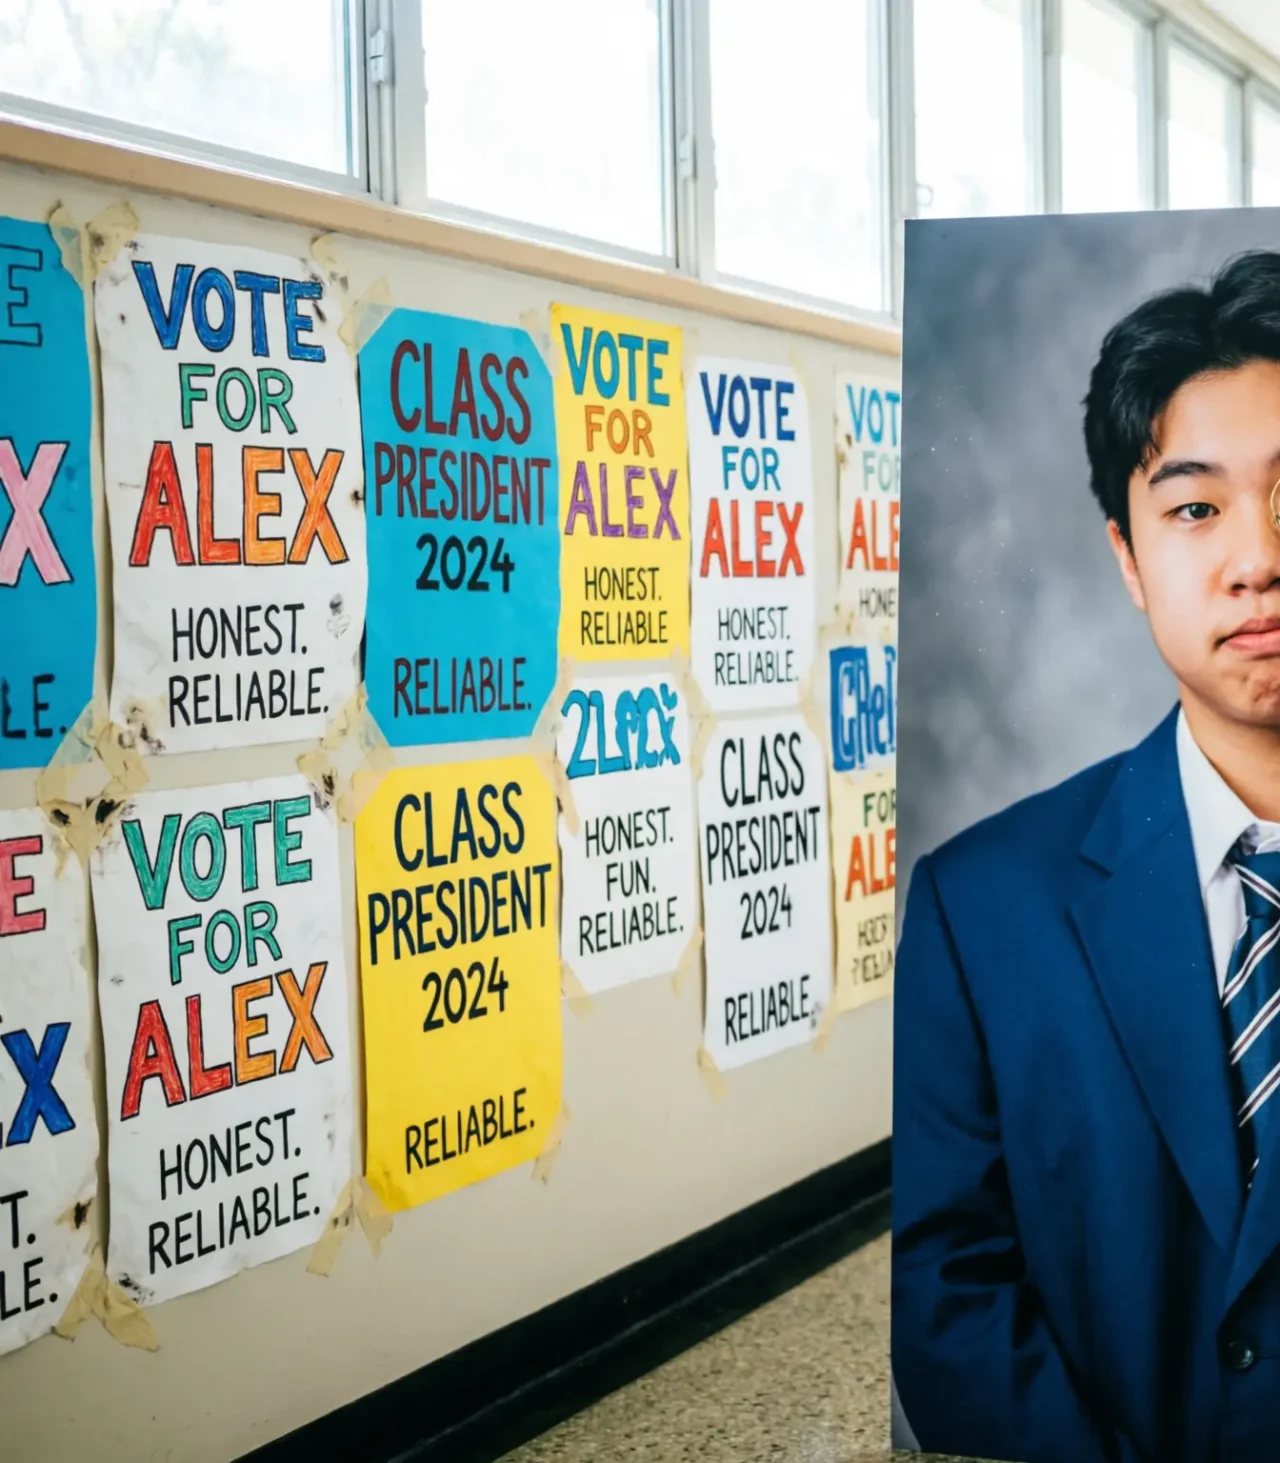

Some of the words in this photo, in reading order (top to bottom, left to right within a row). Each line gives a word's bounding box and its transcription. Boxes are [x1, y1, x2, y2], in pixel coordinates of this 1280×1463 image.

[131, 260, 326, 363] VOTE
[178, 363, 298, 434] FOR
[389, 338, 532, 445] CLASS
[560, 322, 670, 407] VOTE
[584, 404, 655, 458] FOR
[698, 371, 796, 442] VOTE
[128, 440, 350, 568] ALEX
[374, 441, 552, 527] PRESIDENT
[564, 460, 682, 541] ALEX
[721, 445, 782, 491] FOR
[415, 532, 516, 593] 2024
[699, 497, 806, 578] ALEX
[584, 566, 662, 601] HONEST.
[171, 602, 308, 662] HONEST.
[718, 605, 791, 641] HONEST.
[168, 666, 330, 728] RELIABLE.
[392, 656, 533, 718] RELIABLE.
[715, 649, 800, 687] RELIABLE.
[720, 731, 805, 808] CLASS
[121, 795, 313, 911] VOTE
[393, 780, 526, 873] CLASS
[585, 806, 674, 858] HONEST.
[706, 805, 821, 886] PRESIDENT
[368, 863, 552, 966] PRESIDENT
[606, 856, 657, 902] FUN.
[740, 882, 793, 940] 2024
[167, 900, 283, 985] FOR
[579, 896, 684, 957] RELIABLE.
[422, 956, 509, 1033] 2024
[120, 961, 334, 1122] ALEX
[158, 1108, 302, 1201] HONEST.
[406, 1087, 535, 1175] RELIABLE.
[148, 1171, 321, 1275] RELIABLE.
